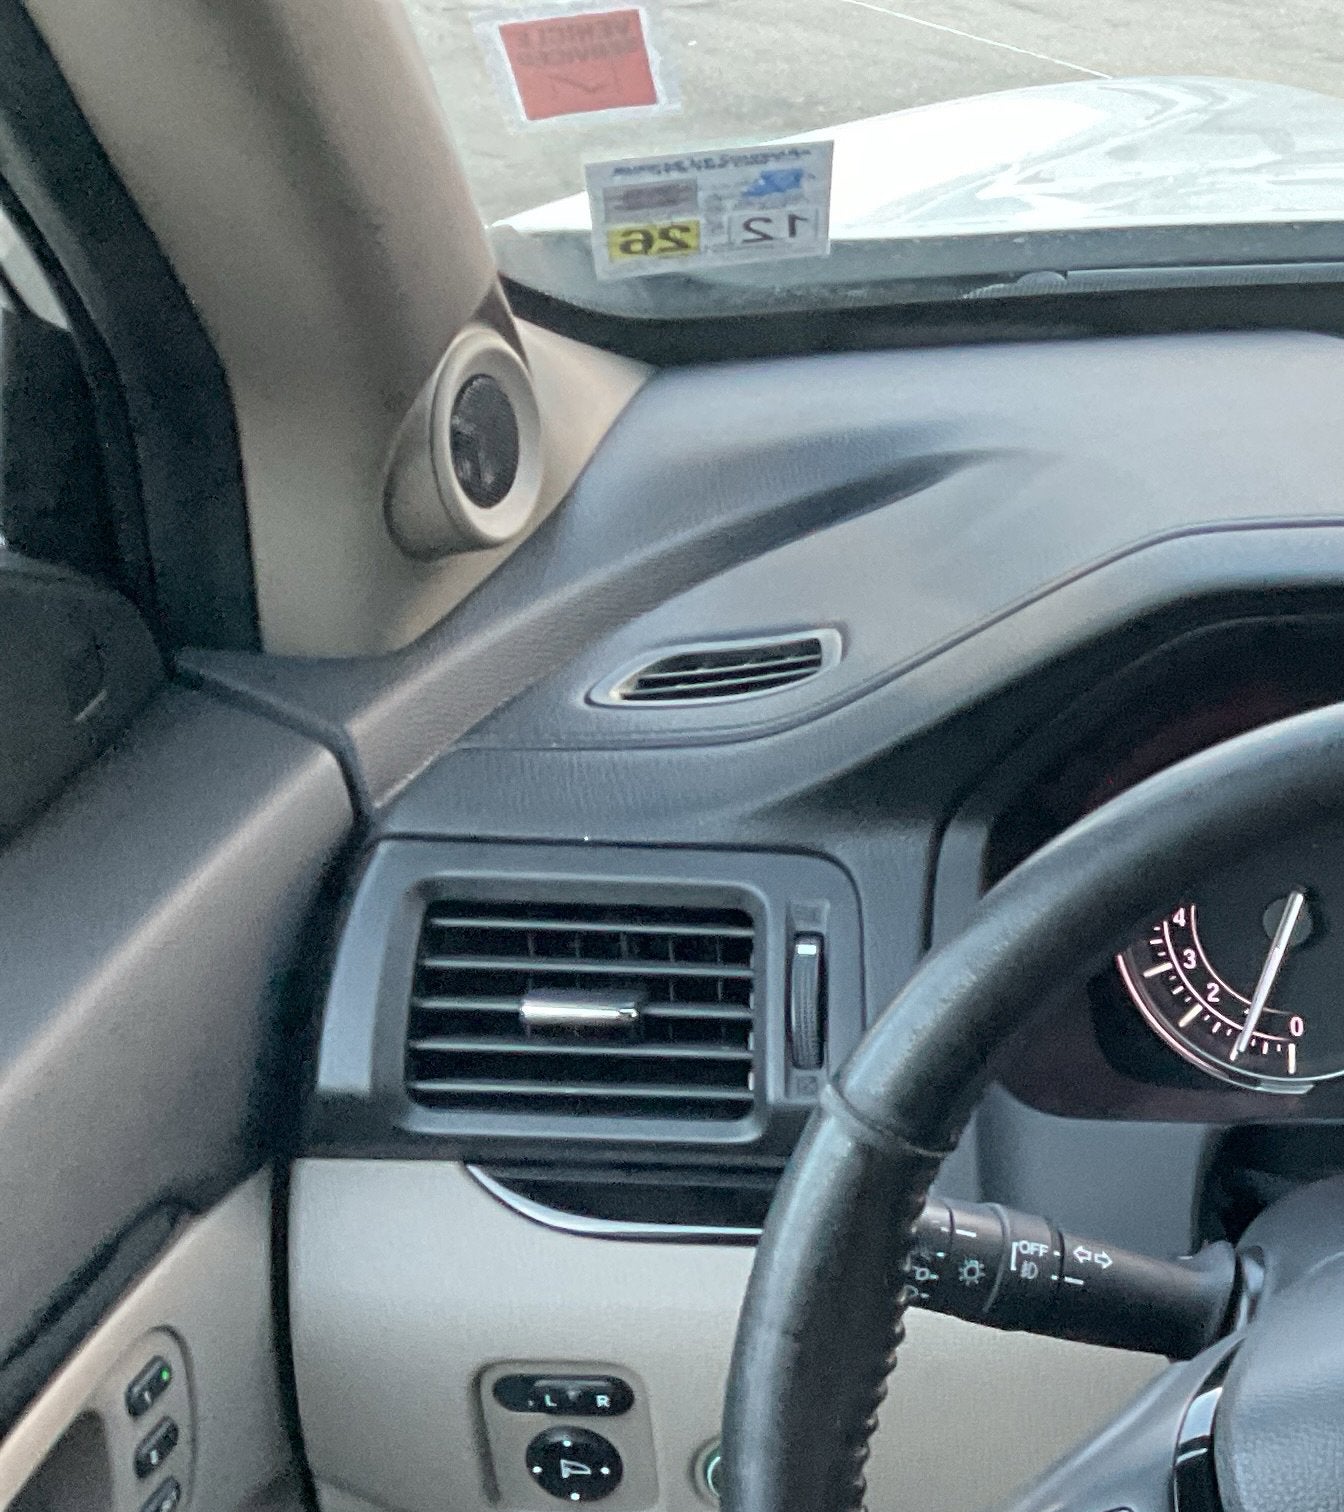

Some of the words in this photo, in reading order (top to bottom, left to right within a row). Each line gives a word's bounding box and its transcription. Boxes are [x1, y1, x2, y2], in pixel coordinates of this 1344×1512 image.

[1172, 907, 1187, 927] 4
[1183, 948, 1197, 970] 3
[1205, 982, 1220, 1003] 2
[1289, 1015, 1304, 1037] 0
[1017, 1240, 1049, 1257] OFF
[543, 1393, 557, 1407] L
[596, 1394, 611, 1408] R
